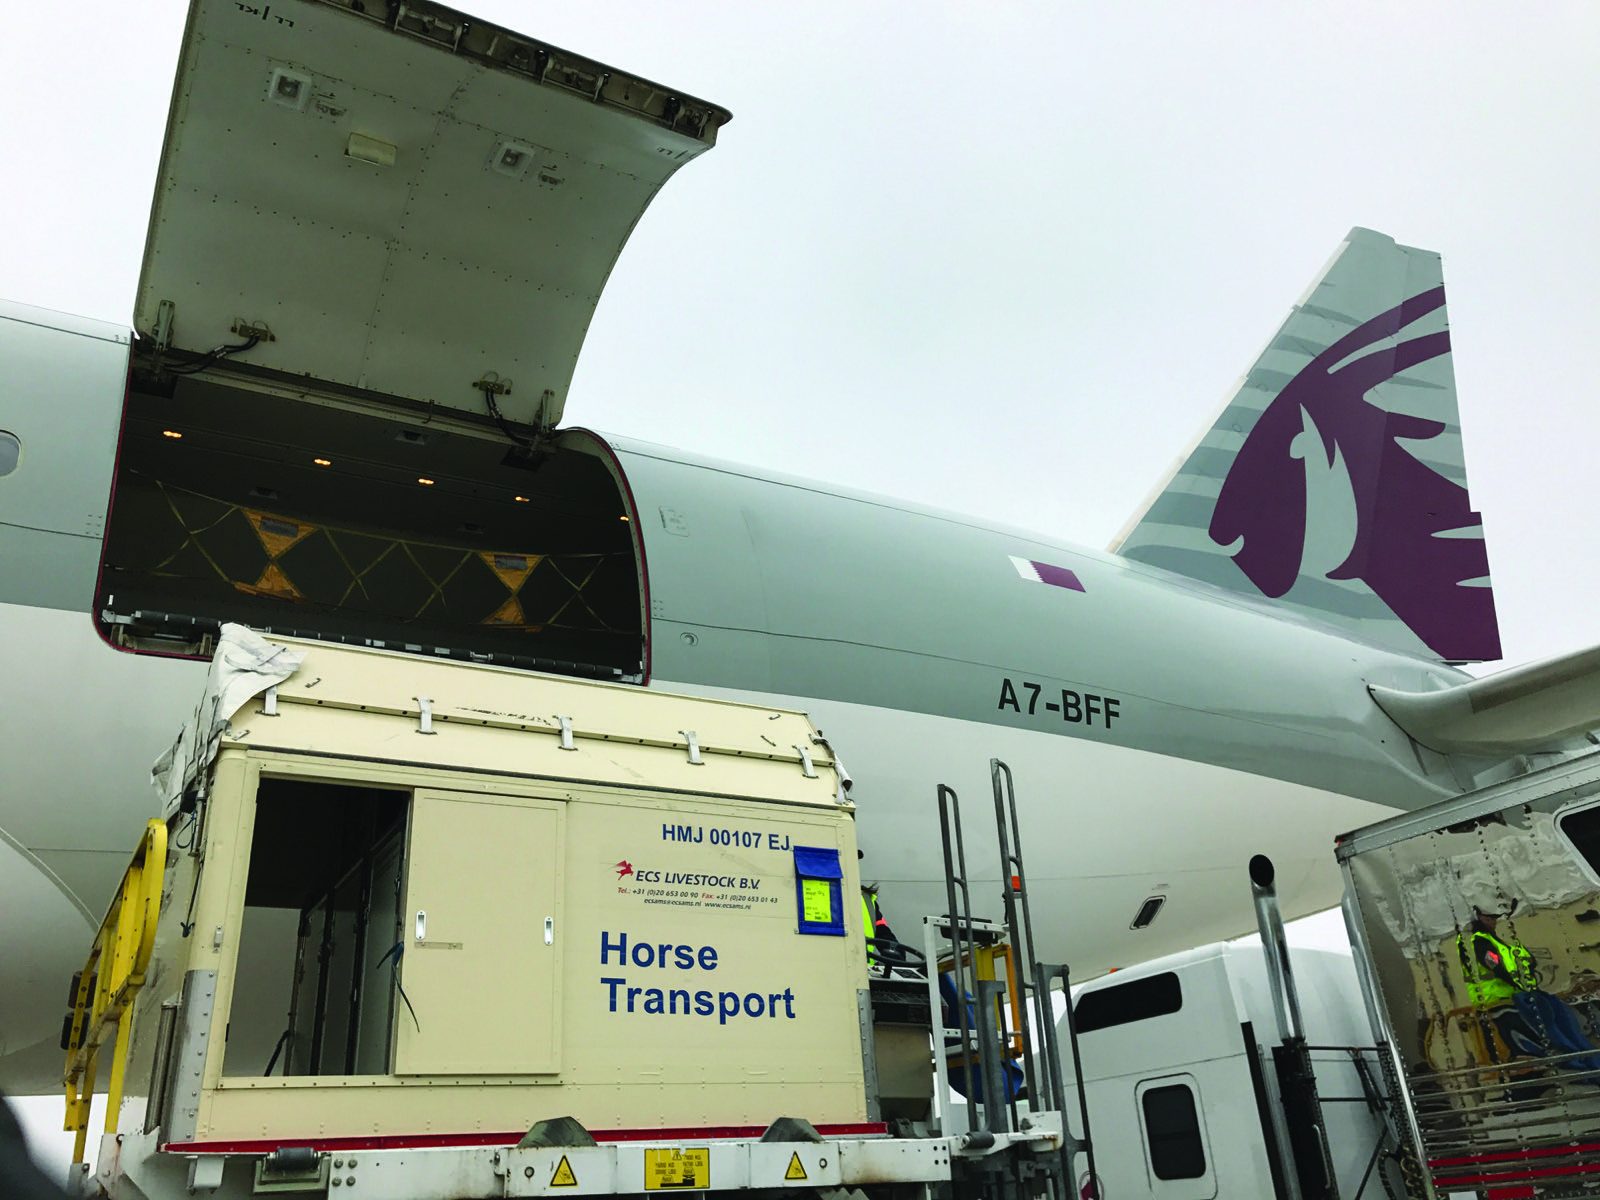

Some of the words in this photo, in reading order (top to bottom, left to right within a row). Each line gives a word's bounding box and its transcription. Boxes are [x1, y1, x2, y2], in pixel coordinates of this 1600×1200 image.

[998, 678, 1120, 729] A7-BFF
[662, 823, 703, 843] HMJ
[709, 828, 762, 848] 00107
[768, 834, 790, 851] EJ
[635, 870, 661, 883] ECS
[664, 872, 736, 888] LIVESTOCK
[739, 878, 761, 890] B.V.
[647, 888, 665, 897] (0)20
[729, 894, 746, 902] (0)20
[704, 901, 751, 910] www.ecsams.nl
[600, 931, 719, 971] Horse
[600, 977, 796, 1025] Transport
